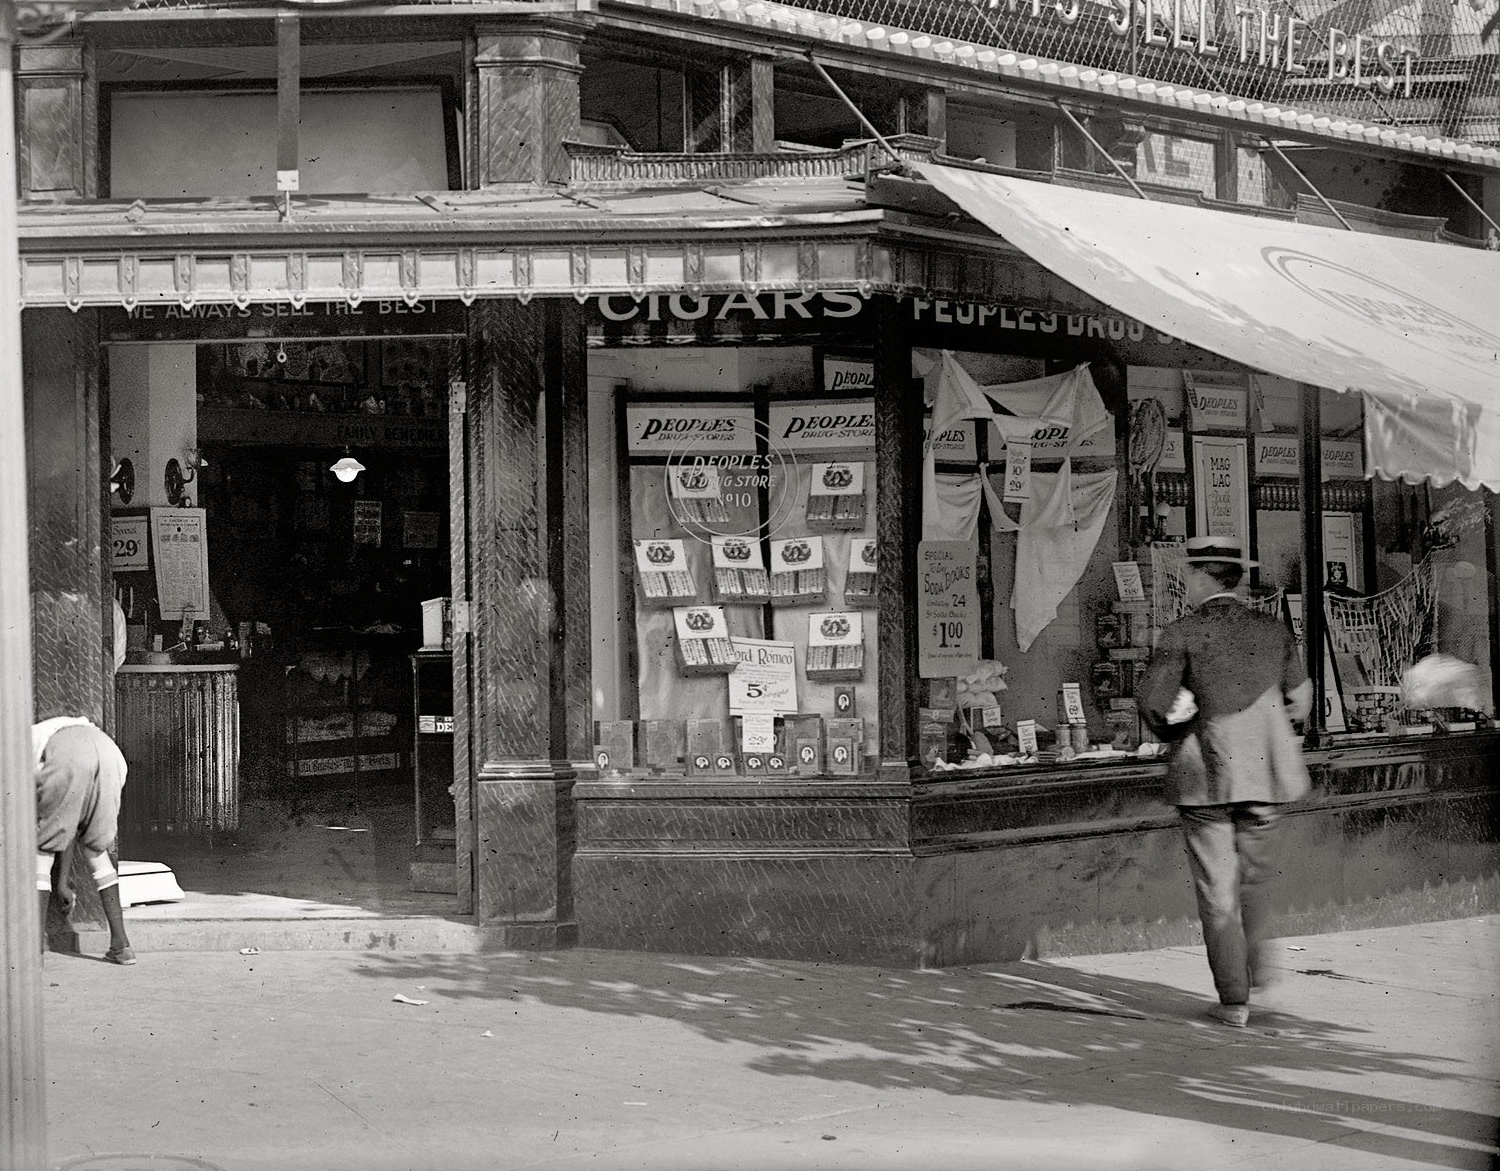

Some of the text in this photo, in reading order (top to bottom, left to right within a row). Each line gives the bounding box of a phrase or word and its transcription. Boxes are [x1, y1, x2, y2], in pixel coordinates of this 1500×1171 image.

[1235, 4, 1308, 74] THE
[1328, 26, 1422, 99] BEST
[128, 299, 439, 320] WE ALWAYS SELL THE BEST
[598, 291, 863, 321] CIGARS
[832, 370, 874, 389] PEOPL
[639, 416, 737, 440] PEOPLES
[685, 453, 774, 487] PEOPLES
[1210, 456, 1231, 471] MAG
[734, 473, 776, 487] STORE
[1211, 473, 1231, 488] LAC
[924, 550, 955, 561] SPECIAL
[951, 593, 967, 608] 24
[757, 647, 793, 665] Romeo
